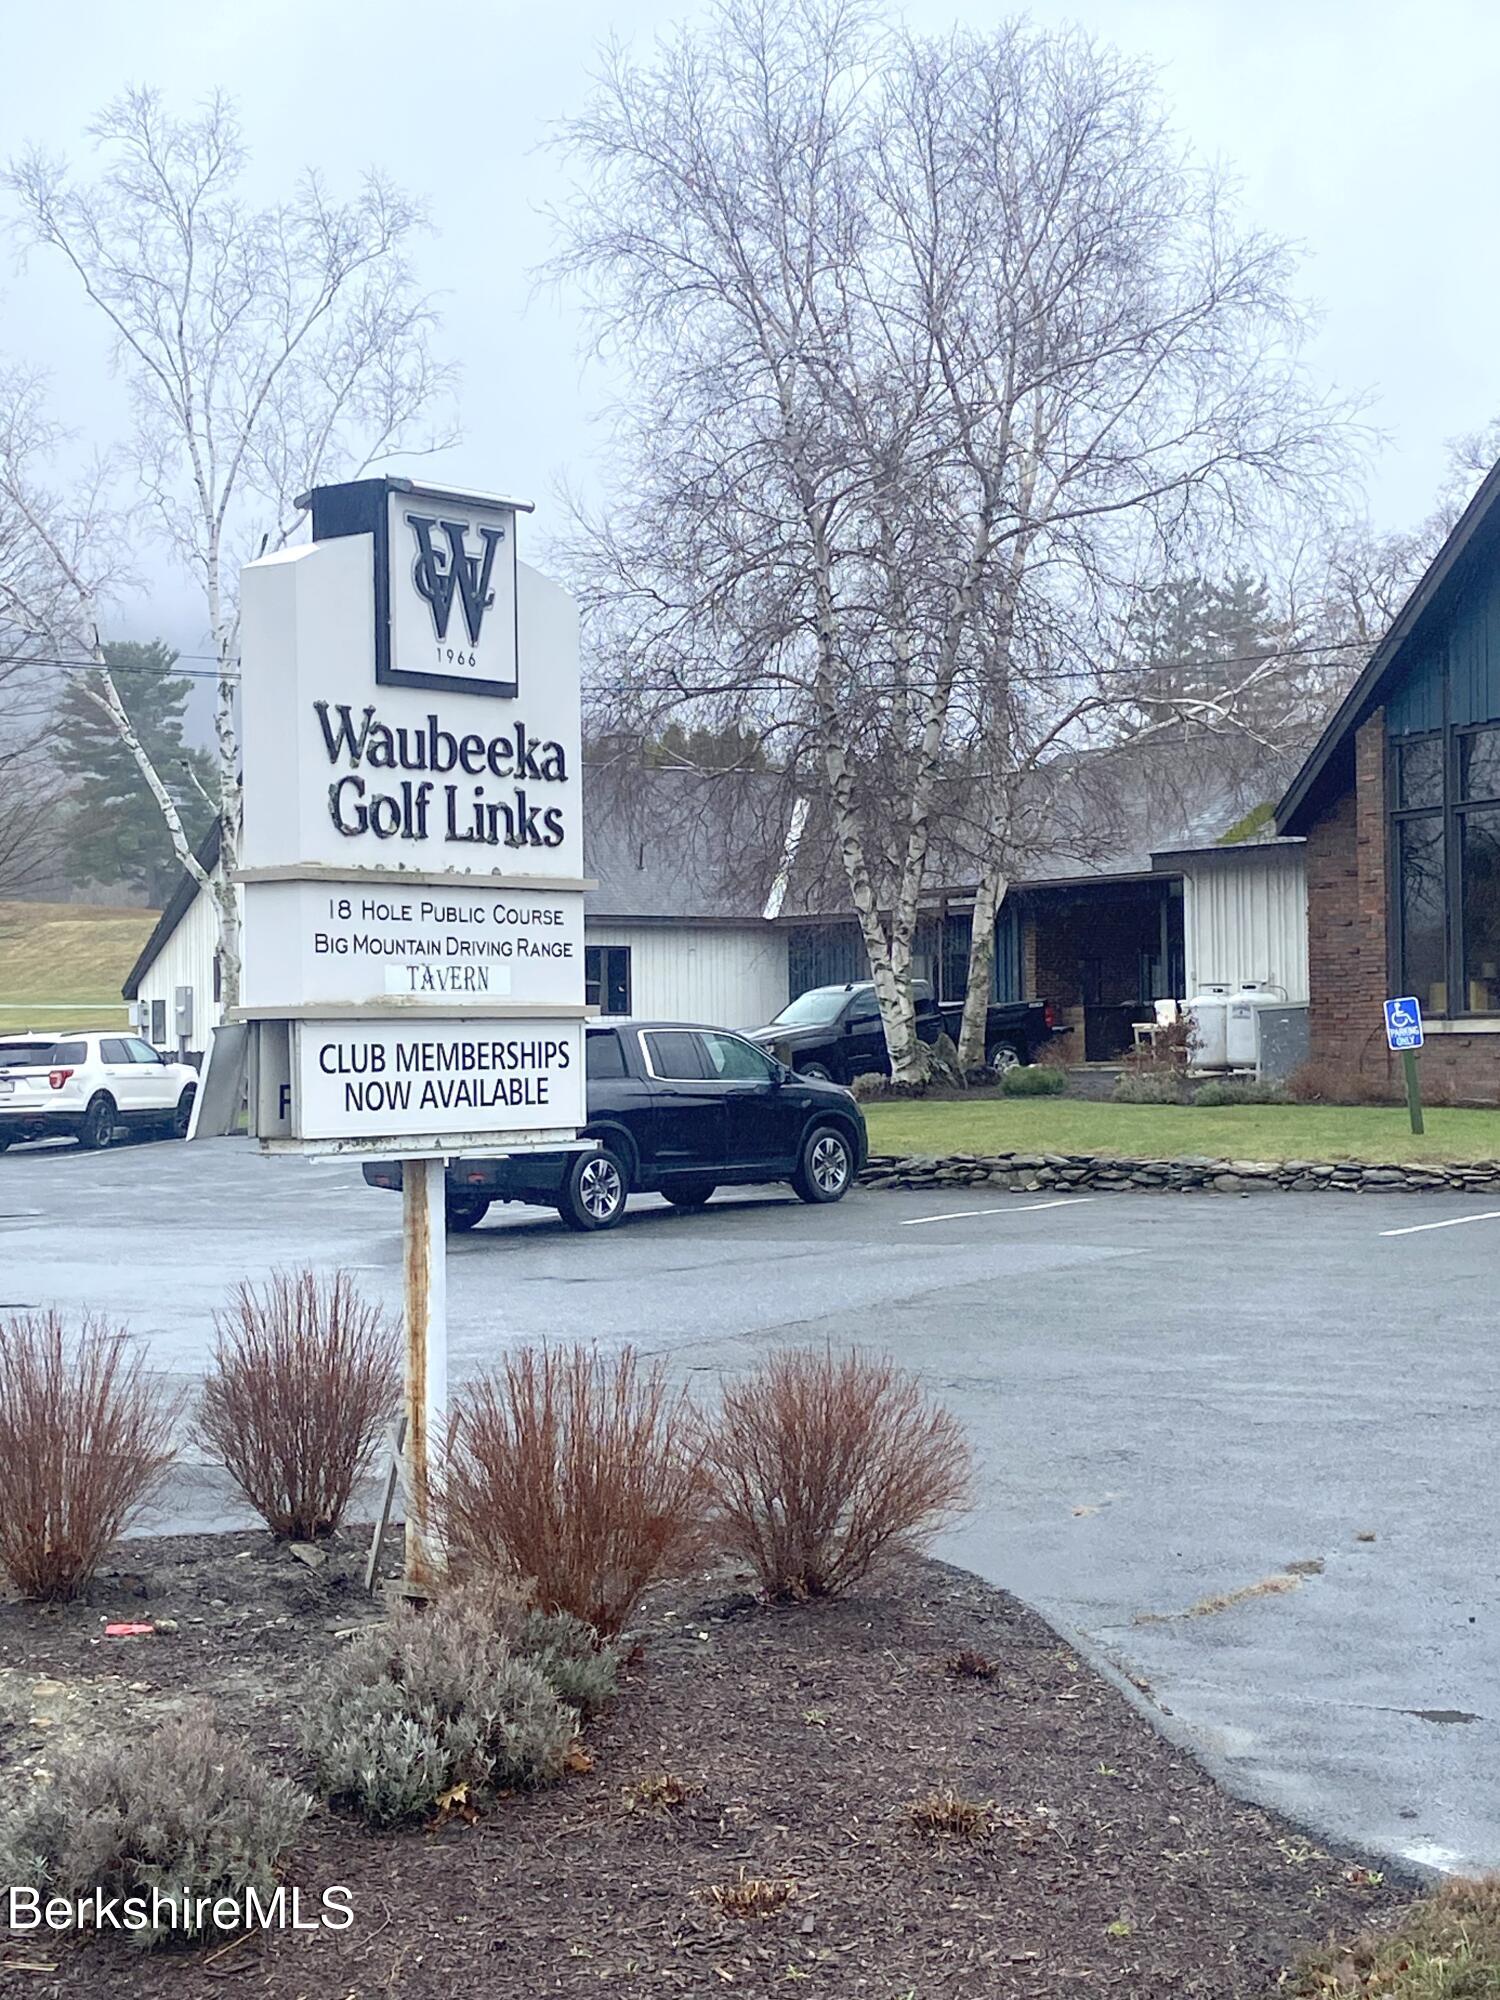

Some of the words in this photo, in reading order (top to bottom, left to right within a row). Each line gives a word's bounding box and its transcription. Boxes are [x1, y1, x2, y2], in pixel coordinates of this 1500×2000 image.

[436, 648, 478, 668] 1966
[313, 700, 569, 782] Waubeeka
[328, 775, 434, 841] Golf
[444, 778, 568, 849] Links
[330, 900, 351, 919] 18
[362, 900, 412, 921] HOLE
[421, 902, 485, 923] PUBLIC
[493, 904, 564, 925] COURSE
[315, 933, 348, 954] BIG
[354, 934, 441, 955] MOUNTAIN
[447, 937, 512, 957] DRIVING
[517, 938, 573, 957] RANGE
[406, 964, 490, 992] TAVERN
[1390, 1026, 1420, 1038] PARKING
[1396, 1035, 1415, 1046] ONLY
[320, 1044, 385, 1074] CLUB
[397, 1041, 569, 1072] MEMBERSHIPS
[346, 1081, 411, 1111] NOW
[420, 1077, 548, 1109] AVAILABLE
